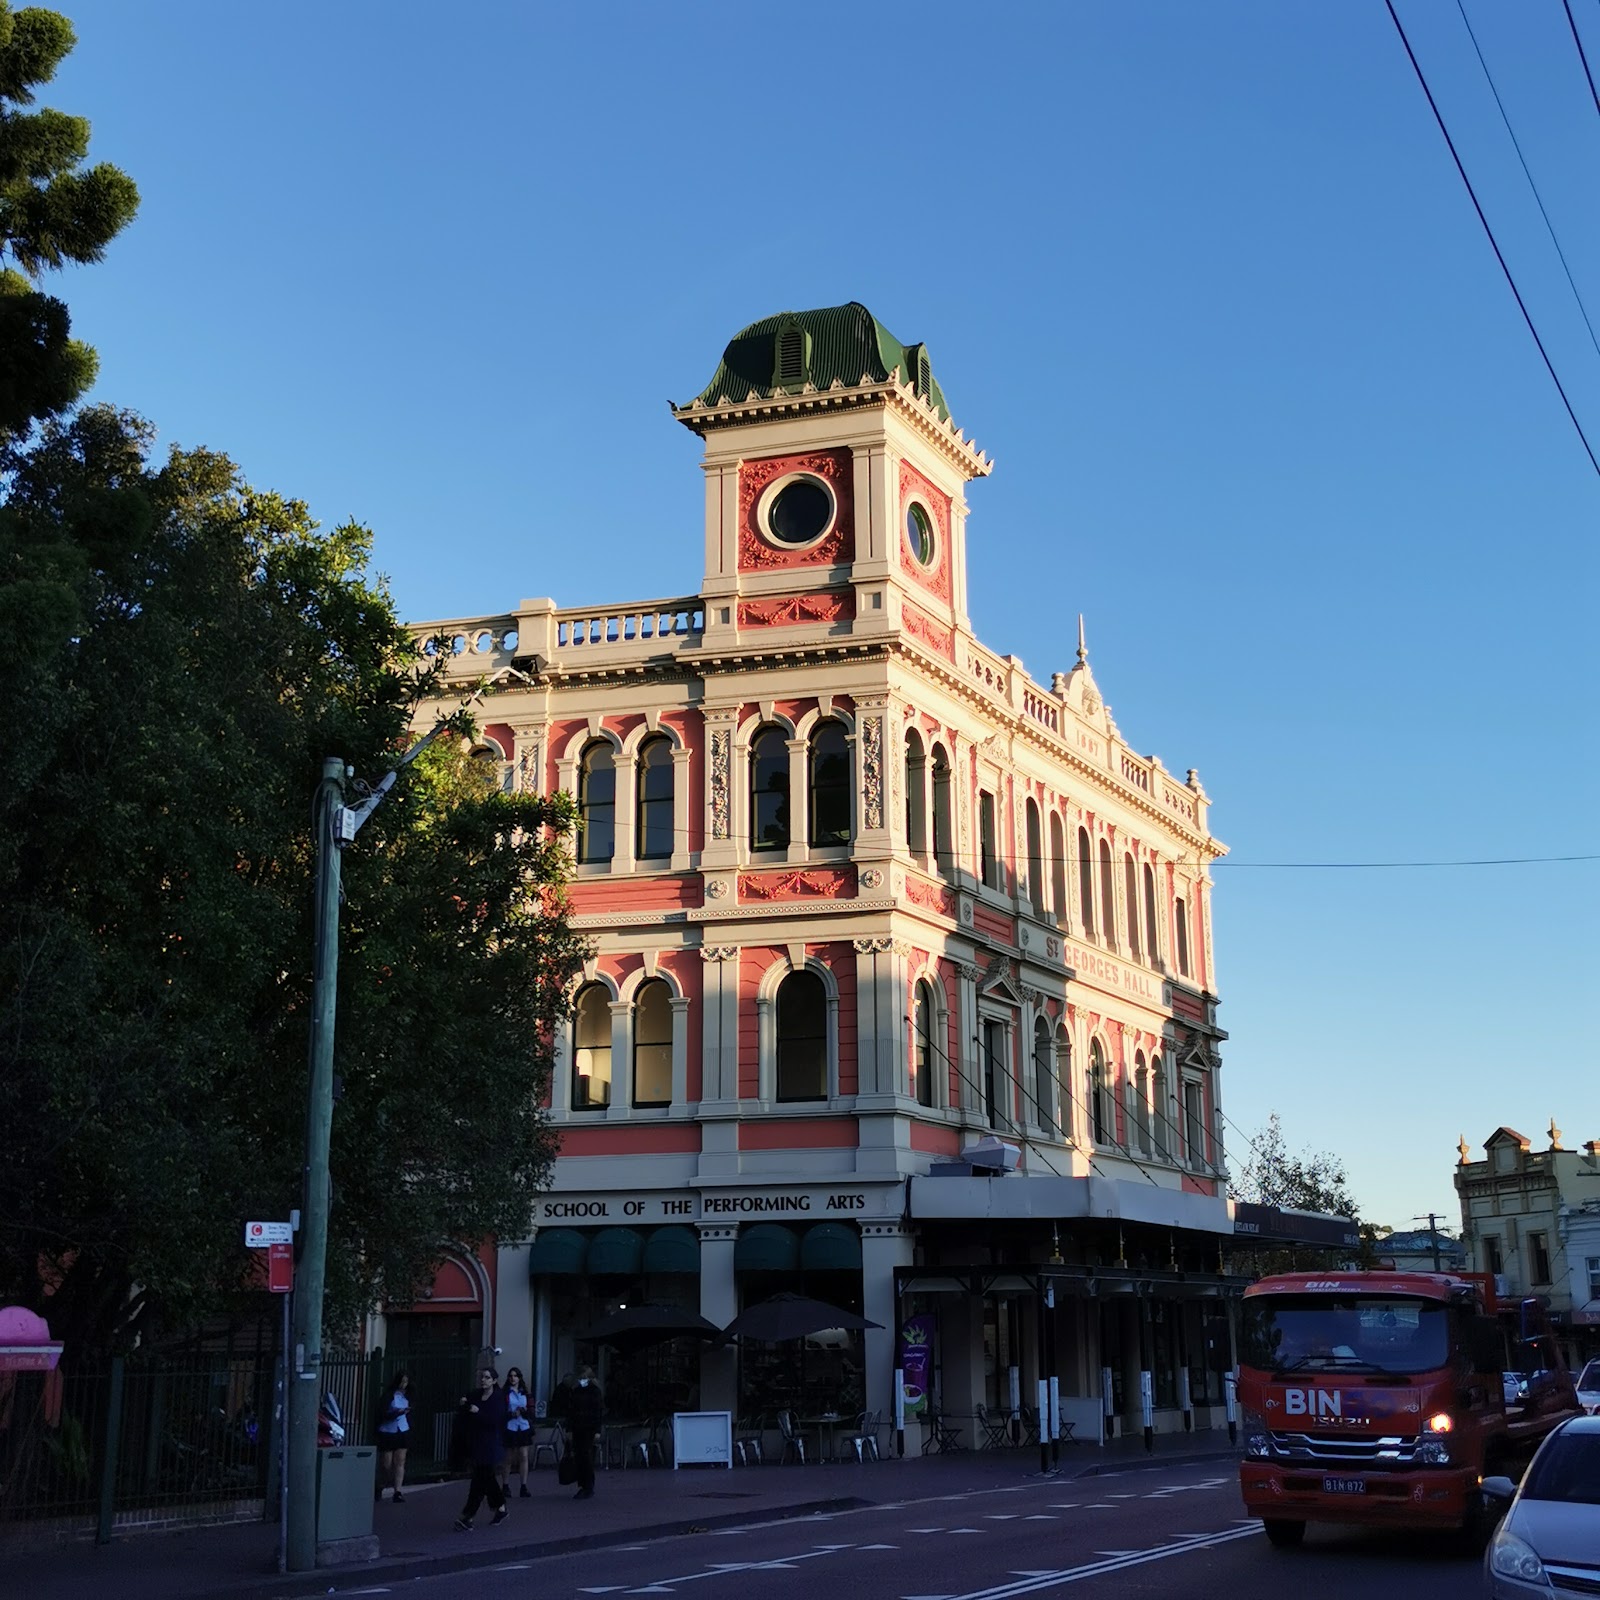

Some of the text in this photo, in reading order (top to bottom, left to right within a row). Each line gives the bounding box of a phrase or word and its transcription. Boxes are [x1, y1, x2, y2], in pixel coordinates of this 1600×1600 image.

[544, 1194, 865, 1217] SCHOOL OF THE PERFORMING ARTS
[1285, 1388, 1342, 1416] BIN
